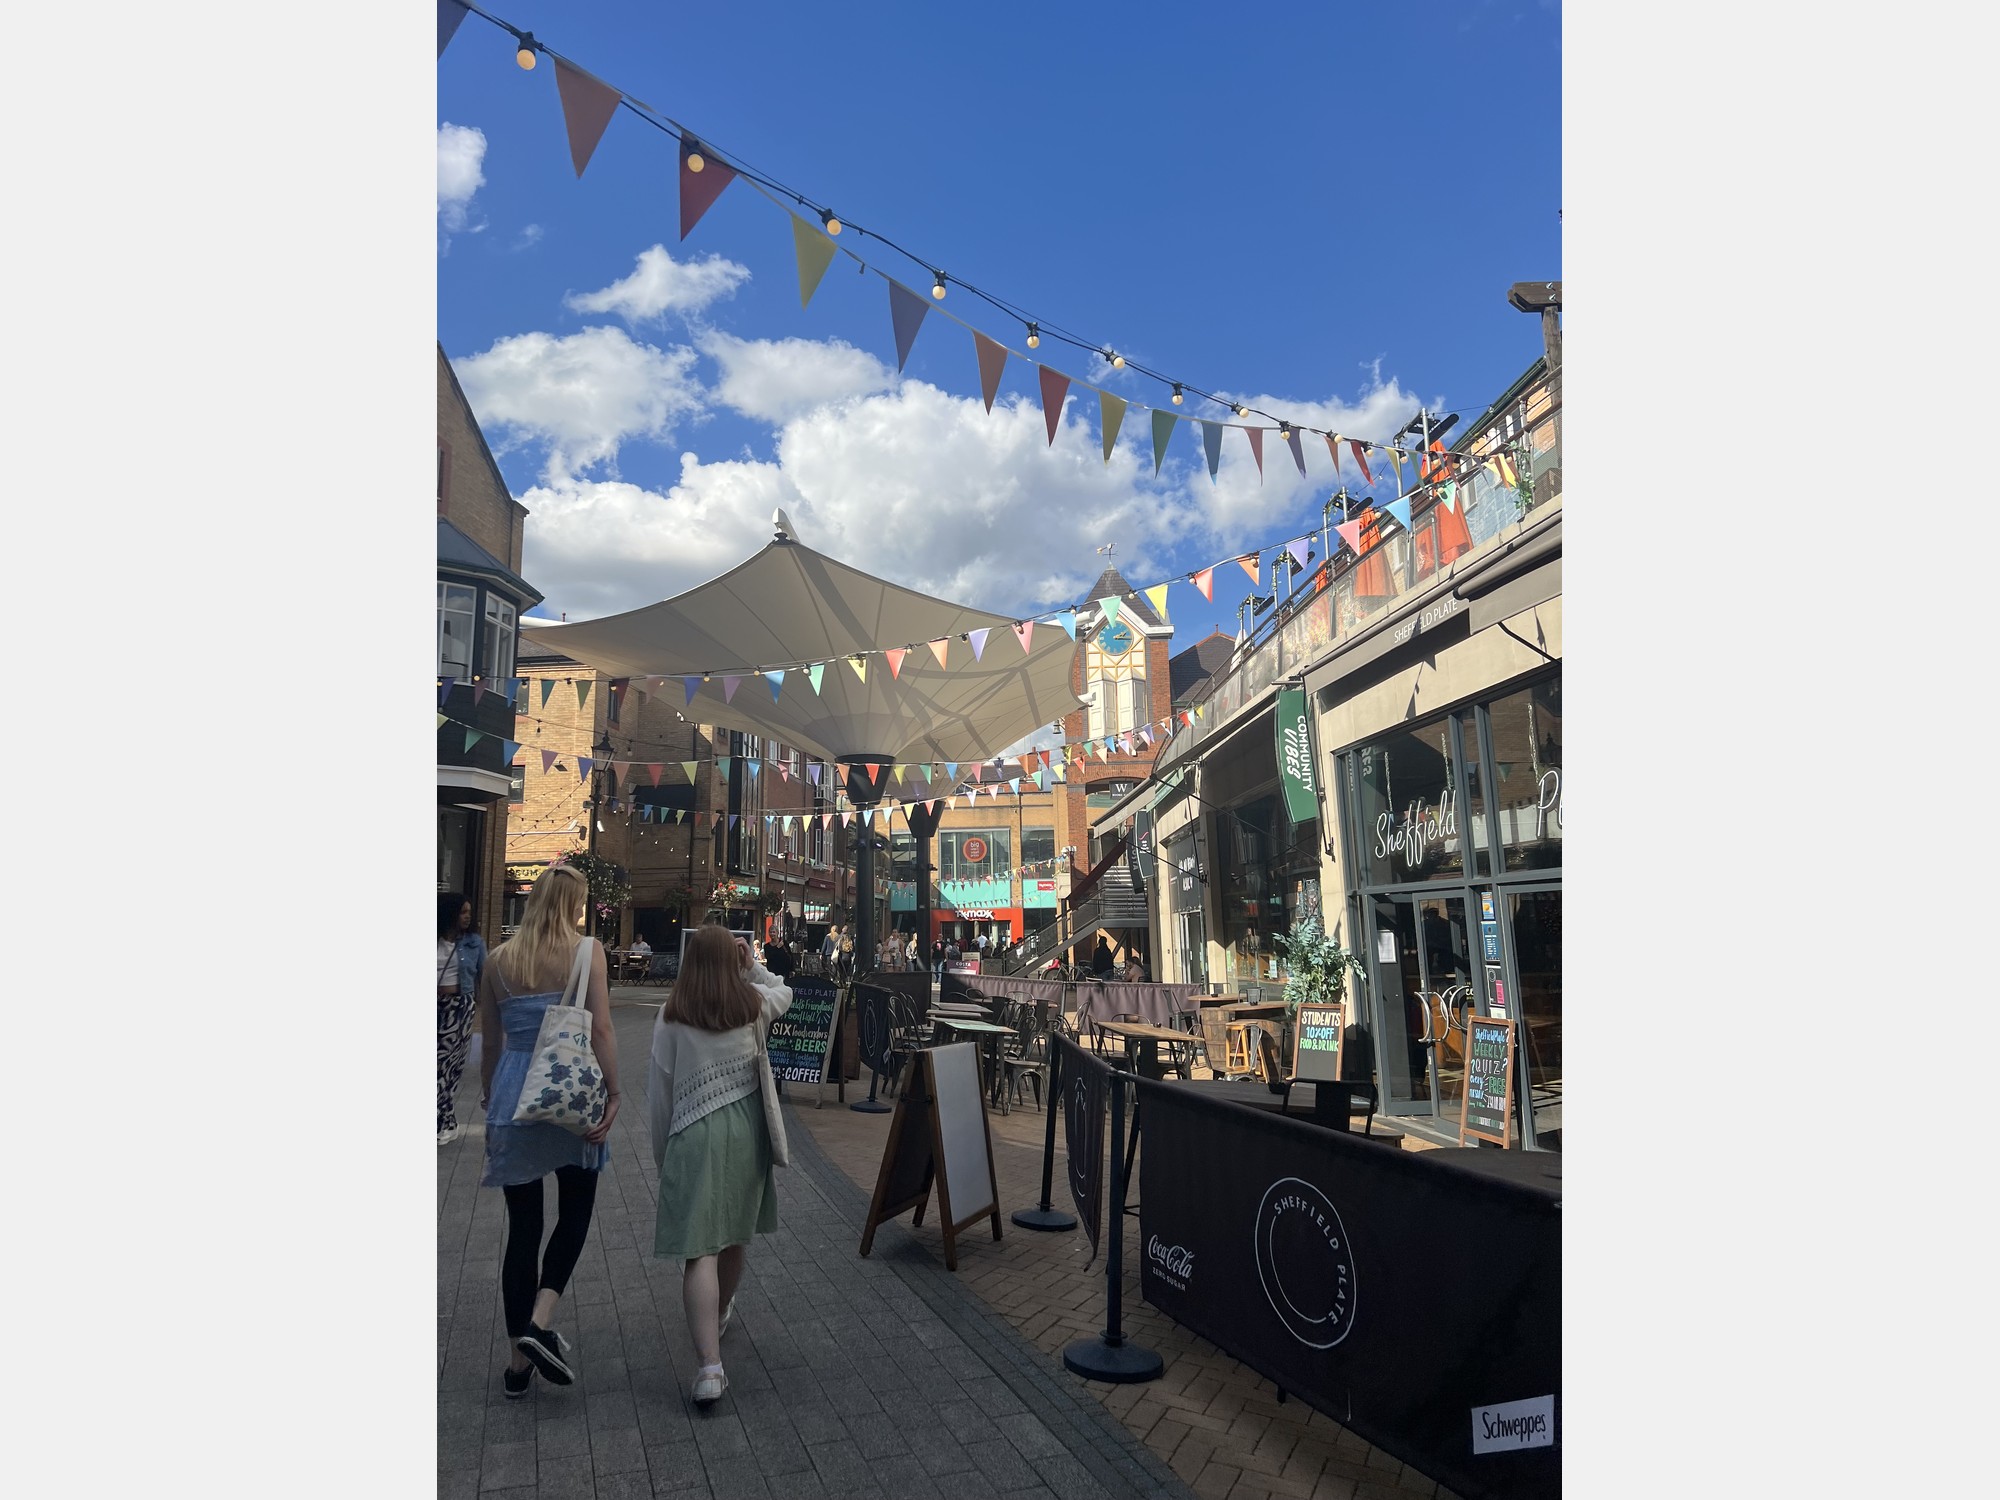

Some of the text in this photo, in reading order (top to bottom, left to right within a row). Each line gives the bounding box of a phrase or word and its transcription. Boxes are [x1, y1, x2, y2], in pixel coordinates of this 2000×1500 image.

[1433, 598, 1458, 622] PLATE
[1284, 727, 1301, 780] VIBES
[1297, 715, 1313, 792] COMMUNITY
[1375, 789, 1457, 868] Sheffield
[814, 988, 837, 998] PLATE
[772, 1022, 792, 1037] SIX
[1301, 1011, 1341, 1027] STUDENTS
[794, 1038, 828, 1054] BEERS
[1473, 1042, 1506, 1059] WEEKLY
[784, 1067, 821, 1083] COFFEE
[1274, 1195, 1347, 1325] SHEFFIELD PLATE
[1152, 1266, 1186, 1291] ZERO SUGAR
[1482, 1411, 1546, 1442] Schweppes
